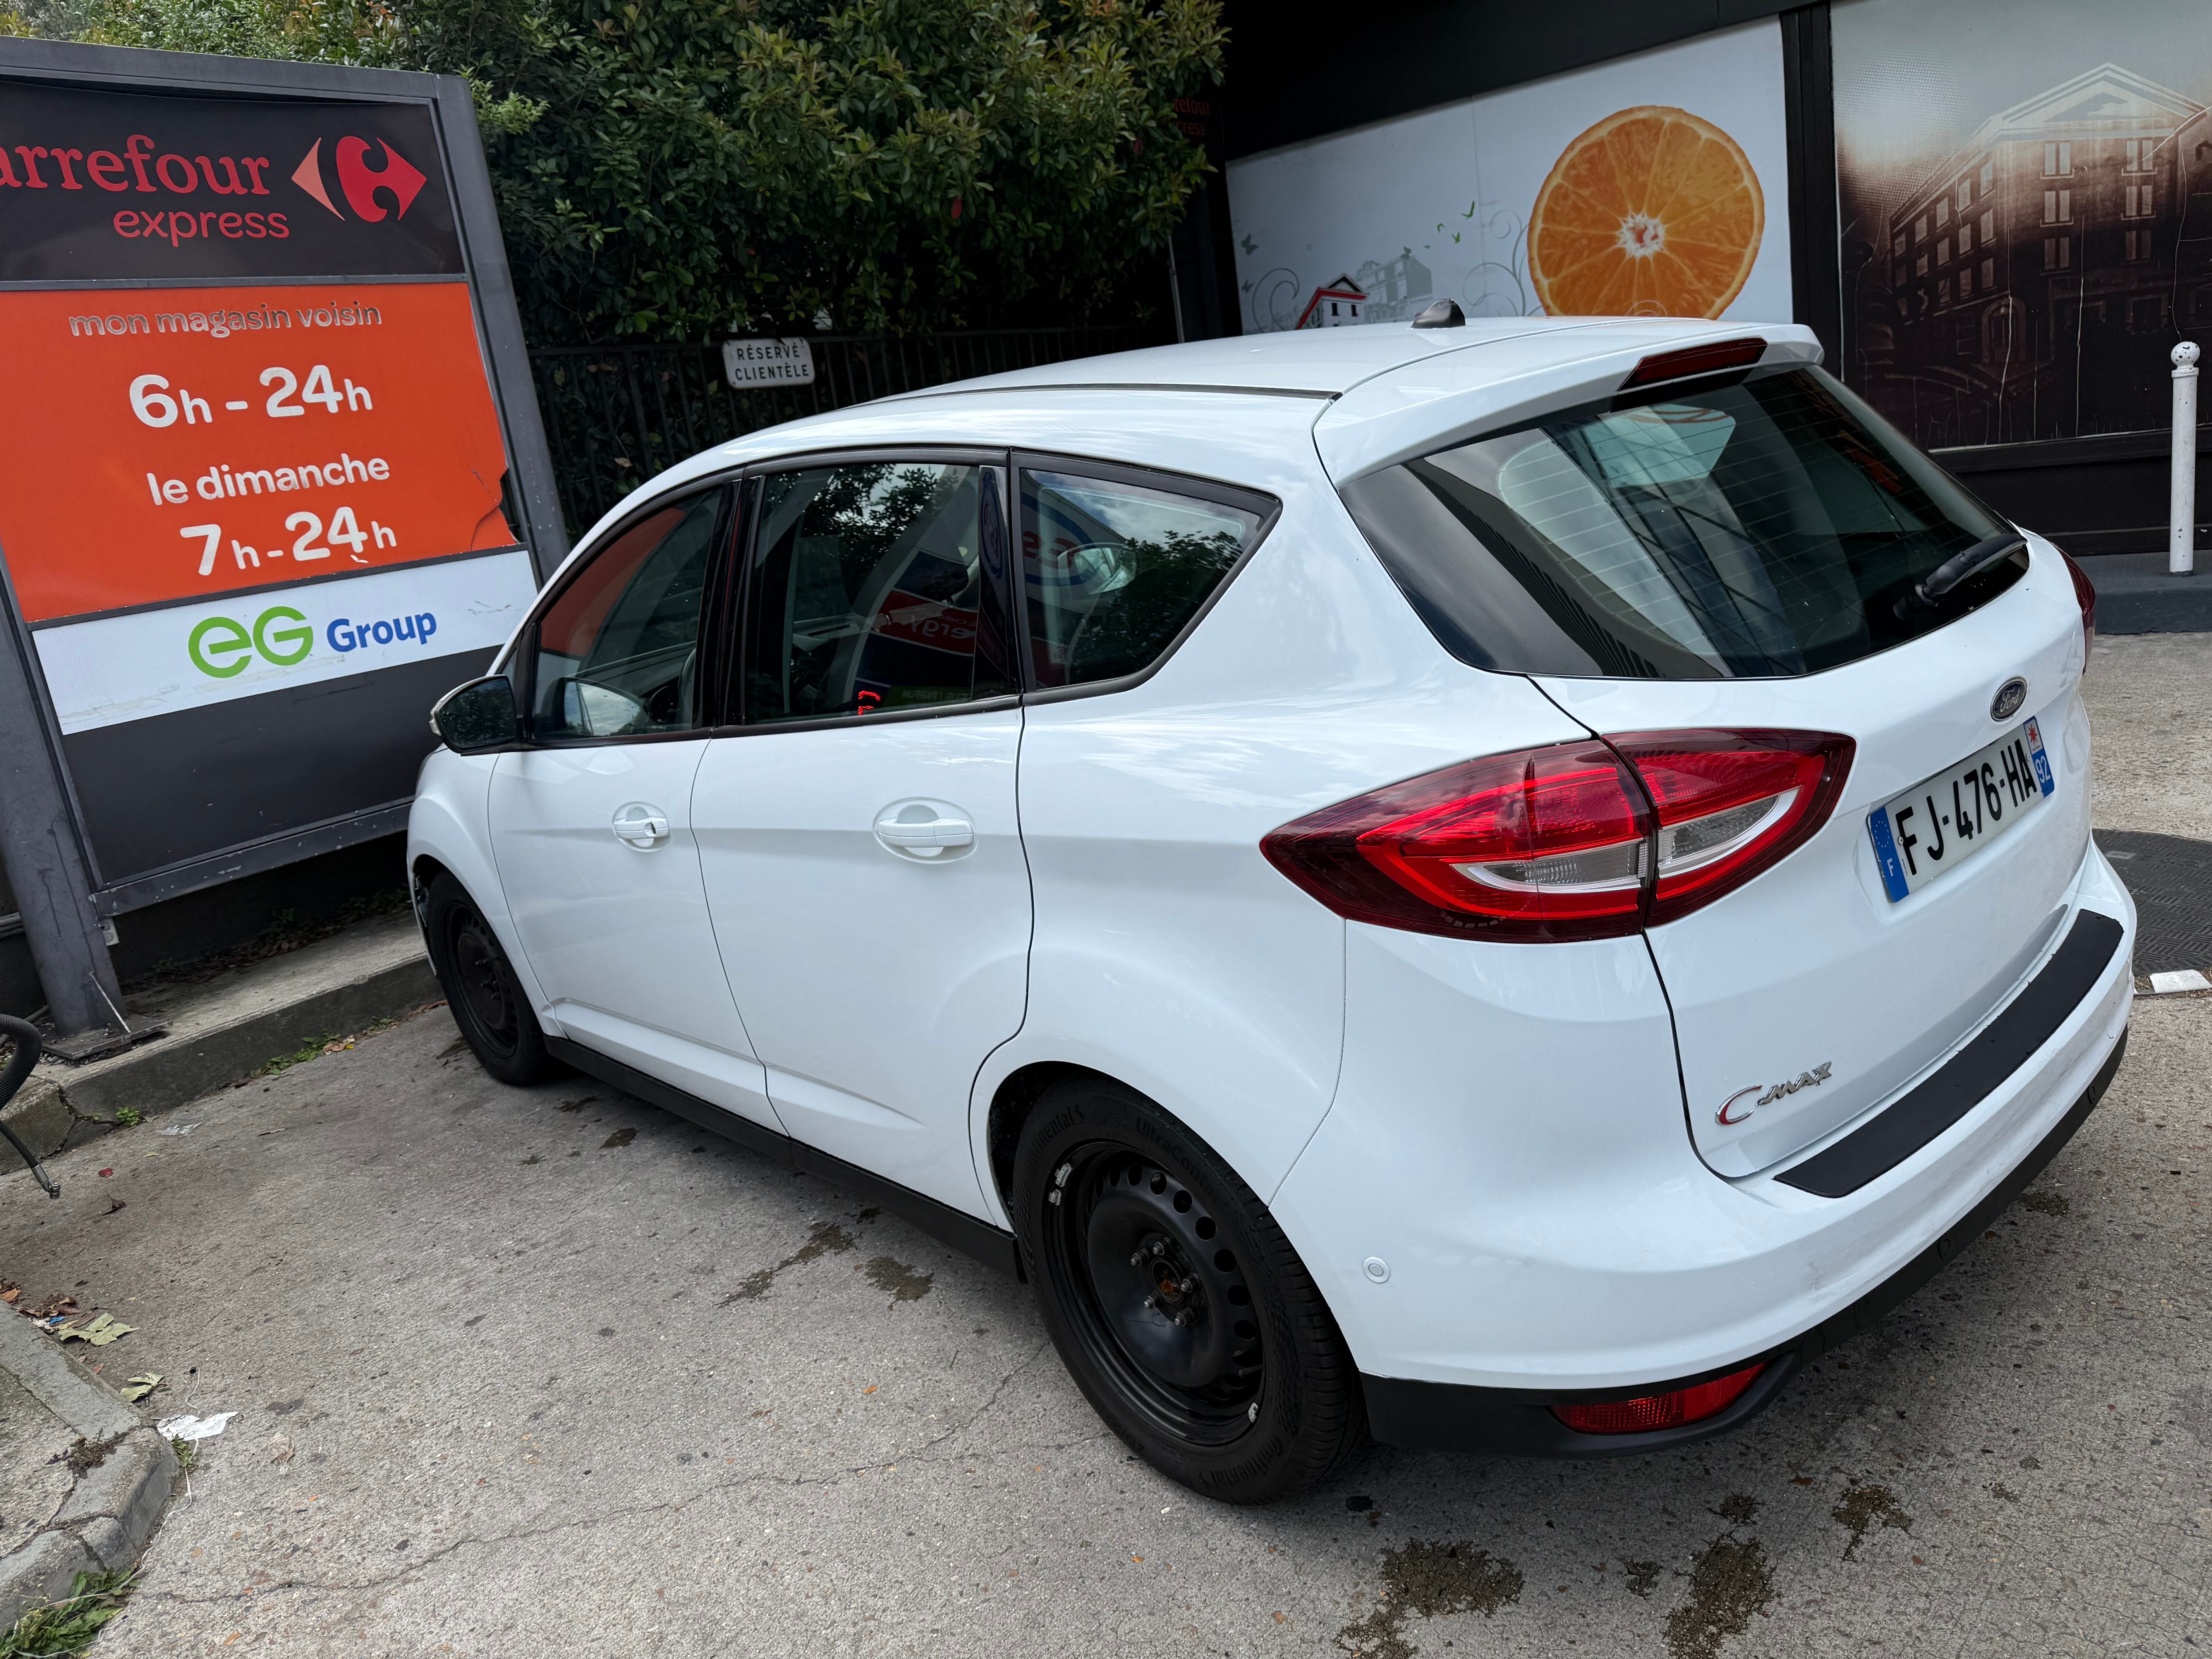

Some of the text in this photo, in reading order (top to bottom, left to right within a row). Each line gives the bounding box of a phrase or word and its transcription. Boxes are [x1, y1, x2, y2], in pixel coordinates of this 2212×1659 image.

[113, 210, 289, 247] express
[68, 301, 383, 338] mon magasin voisin
[737, 342, 800, 361] RÉSERVÉ
[735, 362, 809, 381] CLIENTÈLE
[129, 373, 213, 428] 6h
[259, 364, 373, 418] 24h
[146, 453, 390, 506] le dimanche
[326, 612, 438, 653] Group
[2035, 755, 2051, 784] 92
[1895, 738, 2037, 876] FJ-476-HA
[1887, 857, 1894, 877] F
